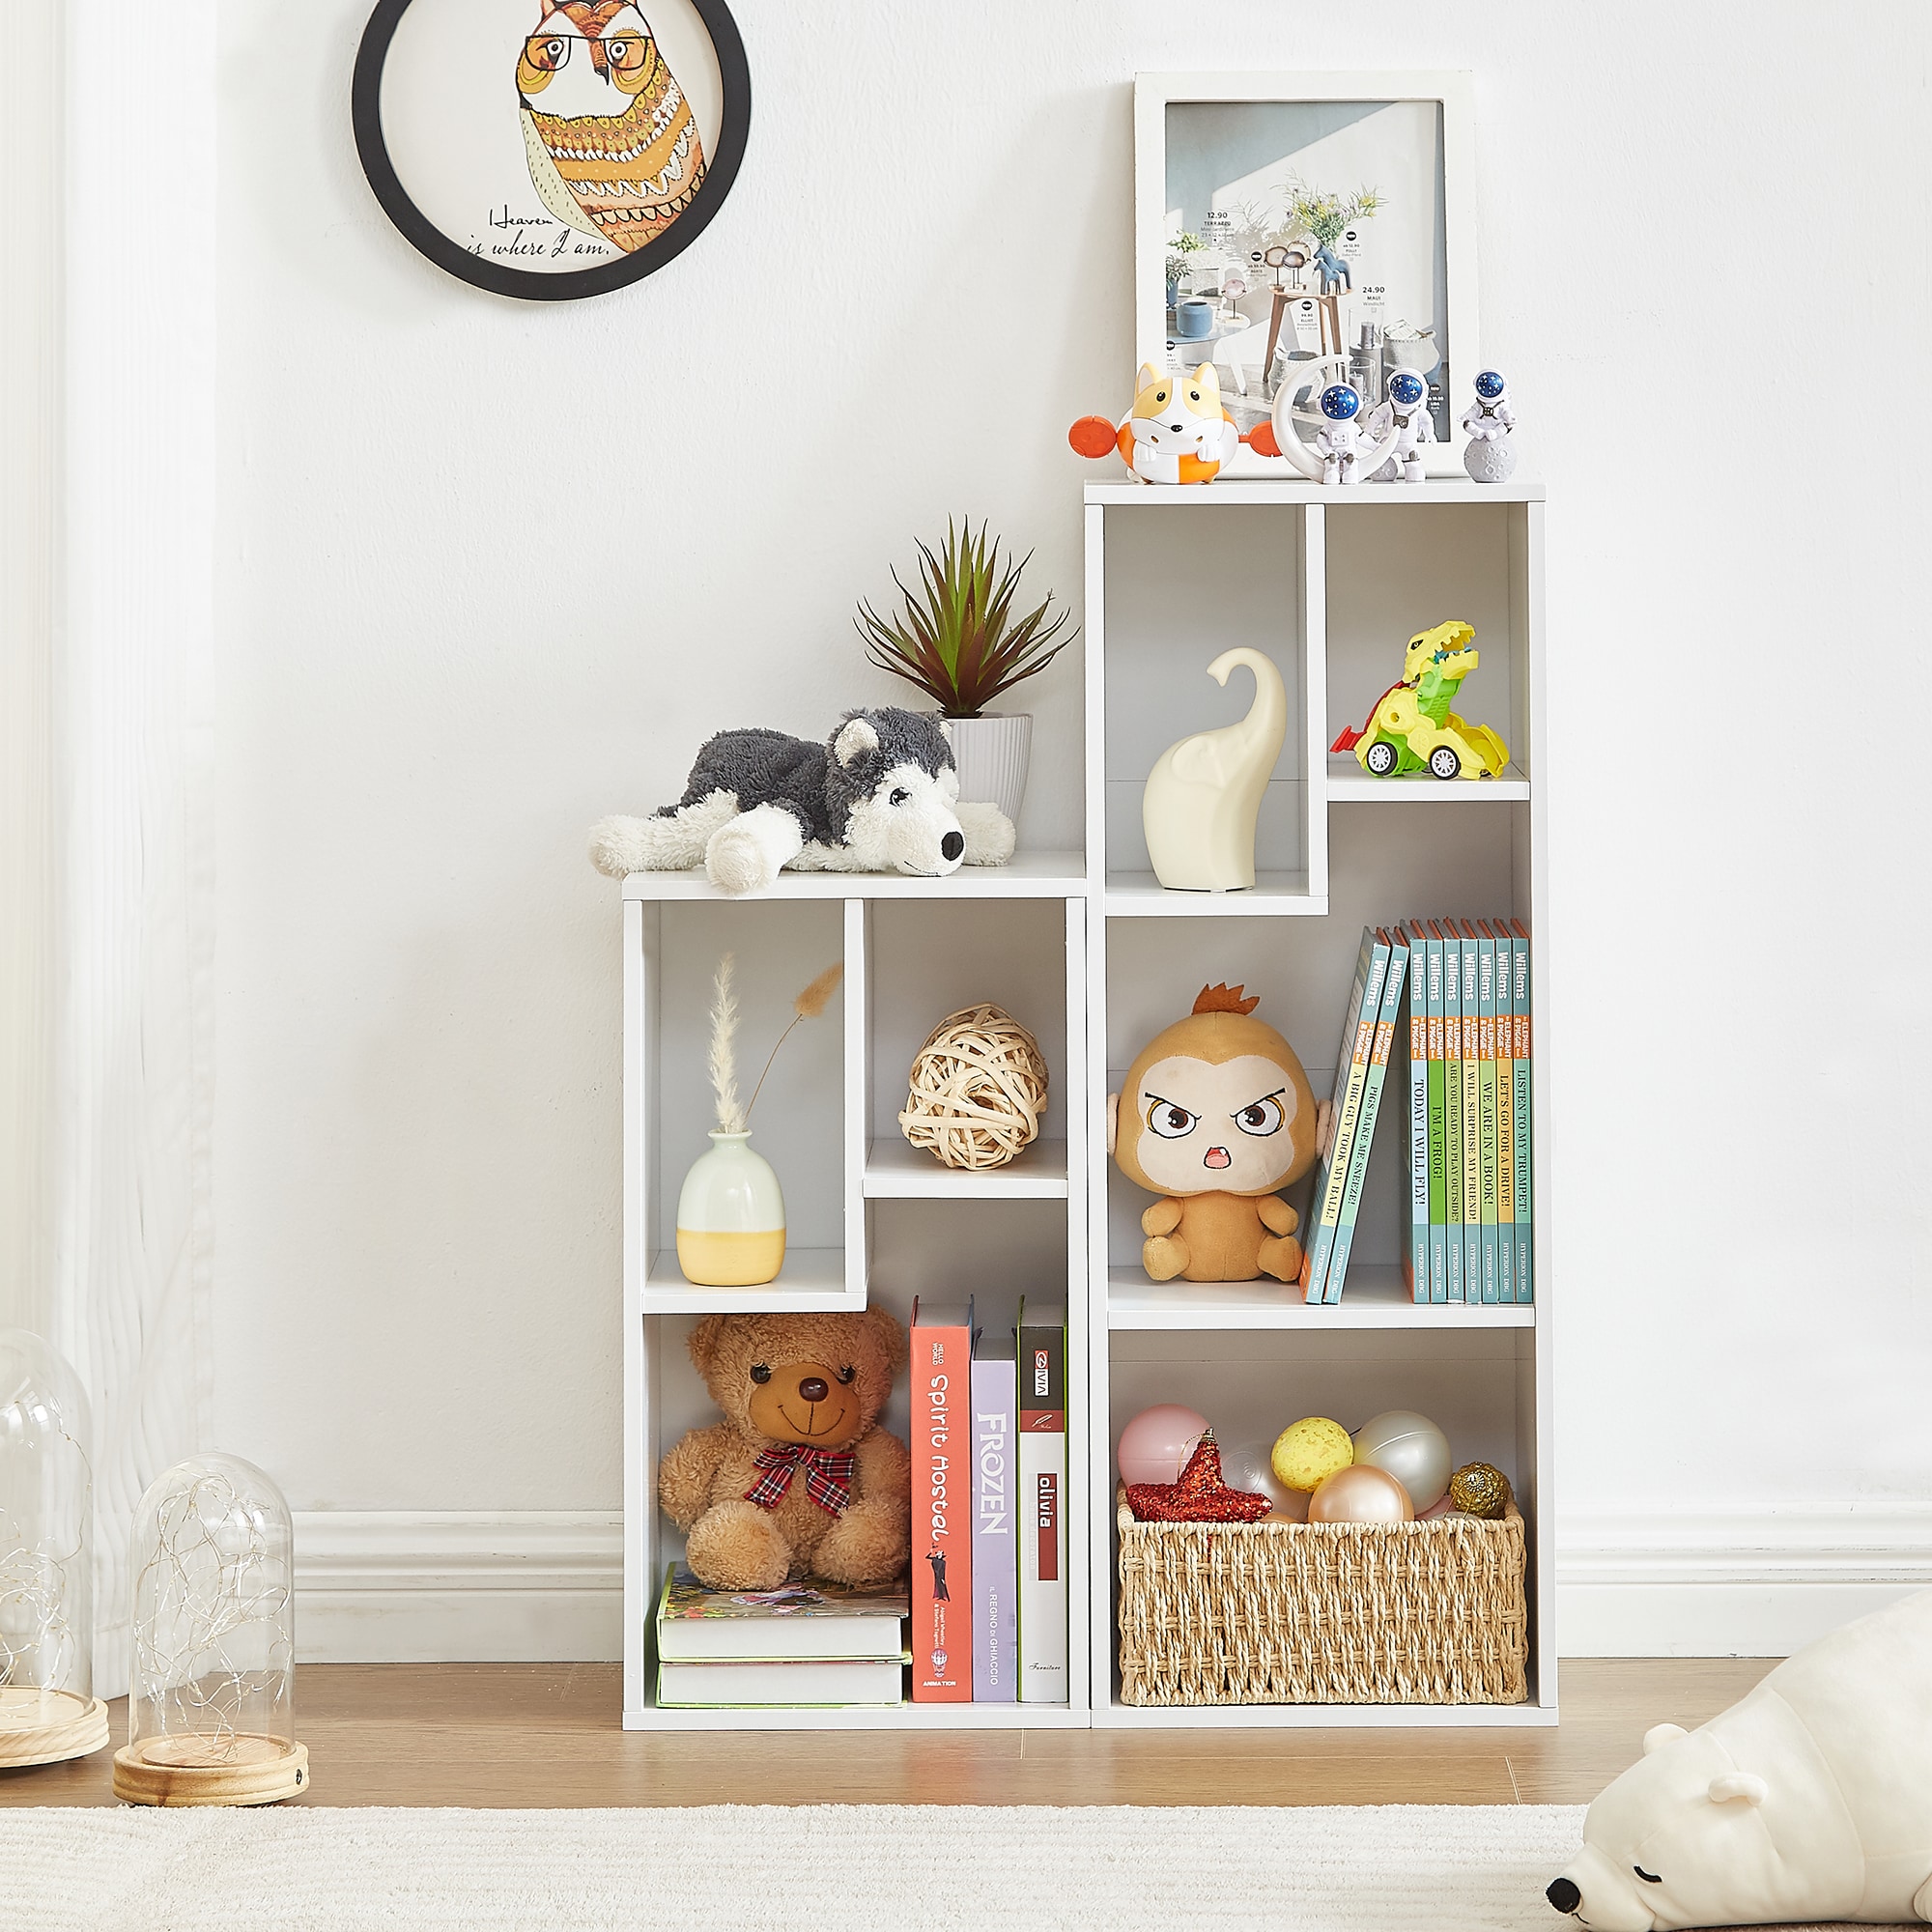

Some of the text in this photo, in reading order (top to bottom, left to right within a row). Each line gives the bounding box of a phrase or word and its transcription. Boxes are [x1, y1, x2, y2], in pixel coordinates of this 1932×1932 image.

[468, 235, 484, 255] is
[492, 228, 547, 255] where
[574, 242, 610, 255] am.
[1366, 959, 1386, 1007] Willems
[1384, 959, 1405, 1007] Willems
[1412, 952, 1424, 1001] Willems
[1430, 953, 1441, 1001] Willems
[1447, 953, 1459, 1001] Willems
[1464, 952, 1476, 1000] Willems
[1481, 953, 1492, 1002] Willems
[1498, 952, 1509, 1000] Willems
[1516, 952, 1527, 1000] Willems
[1350, 1083, 1360, 1102] BIG
[1414, 1079, 1425, 1122] TODAY
[1483, 1082, 1492, 1102] WE
[1500, 1075, 1509, 1107] LET'S
[1345, 1105, 1355, 1128] GUY
[1433, 1106, 1441, 1124] I'M
[1483, 1106, 1492, 1131] ARE
[1500, 1110, 1509, 1126] GO
[1338, 1131, 1351, 1162] TOOK
[1348, 1086, 1378, 1205] PIGS MAKE ME SNEEZE!
[1414, 1136, 1425, 1172] WILL
[1433, 1141, 1442, 1179] FROG!
[1451, 1138, 1459, 1150] TO
[1484, 1136, 1493, 1149] IN
[1500, 1130, 1510, 1152] FOR
[1518, 1069, 1527, 1213] LISTEN TO MY TRUMPET!
[1333, 1165, 1344, 1183] MY
[1468, 1157, 1476, 1173] MY
[1326, 1185, 1340, 1219] BALL!
[1415, 1177, 1426, 1205] FLY!
[1468, 1177, 1477, 1220] FRIEND!
[1484, 1165, 1493, 1205] BOOK!
[1501, 1167, 1510, 1207] DRIVE!
[927, 1374, 950, 1542] Spirit Hostel
[977, 1412, 1009, 1535] FROZEN
[1039, 1477, 1056, 1528] olivia
[989, 1594, 998, 1629] REGNO
[989, 1637, 999, 1686] GHIACCIO
